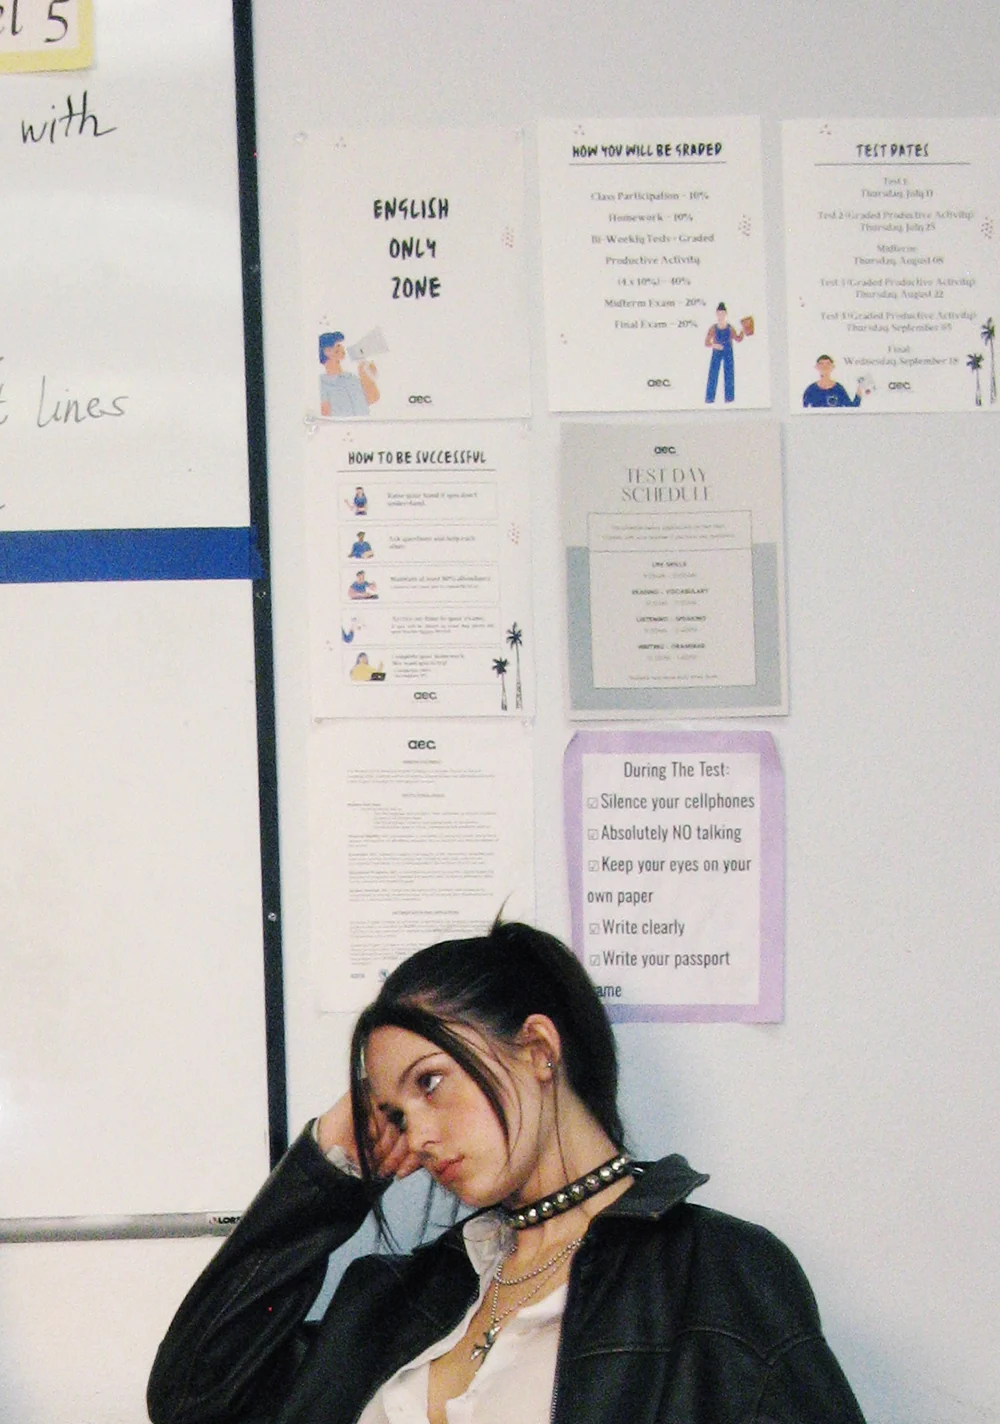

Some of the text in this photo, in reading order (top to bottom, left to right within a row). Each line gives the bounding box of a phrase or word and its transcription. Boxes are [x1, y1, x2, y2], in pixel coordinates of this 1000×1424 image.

[44, 0, 69, 42] 5
[21, 90, 118, 144] with
[572, 142, 723, 158] HOW YOU WILL BE GRADED
[856, 142, 930, 158] TEST DATES
[590, 191, 616, 201] Class
[617, 190, 680, 203] Participation
[689, 190, 710, 201] 10%
[373, 197, 450, 221] ENGLISH
[608, 213, 664, 222] Homework
[673, 212, 694, 222] 10%
[678, 232, 715, 243] Graded
[389, 236, 437, 261] ONLY
[605, 255, 658, 266] Productive
[391, 276, 442, 300] ZONE
[604, 298, 646, 308] Midterm
[648, 298, 676, 308] Exam
[685, 297, 707, 307] 20%
[614, 319, 639, 329] Final
[640, 319, 668, 328] Exam
[677, 318, 699, 329] 20%
[37, 375, 131, 428] lines
[348, 449, 487, 465] HOW TO BE SUCCESSFUL
[627, 466, 707, 484] TEST DAY
[621, 485, 715, 503] SCHEDULE
[623, 760, 730, 780] During The Test:
[600, 792, 756, 812] Silence your cellphones
[601, 823, 743, 844] Absolutely NO talking
[601, 856, 752, 875] Keep your eyes on your
[587, 890, 654, 907] own paper
[602, 918, 686, 937] Write clearly
[602, 950, 731, 969] Write your passport
[594, 984, 622, 998] ame
